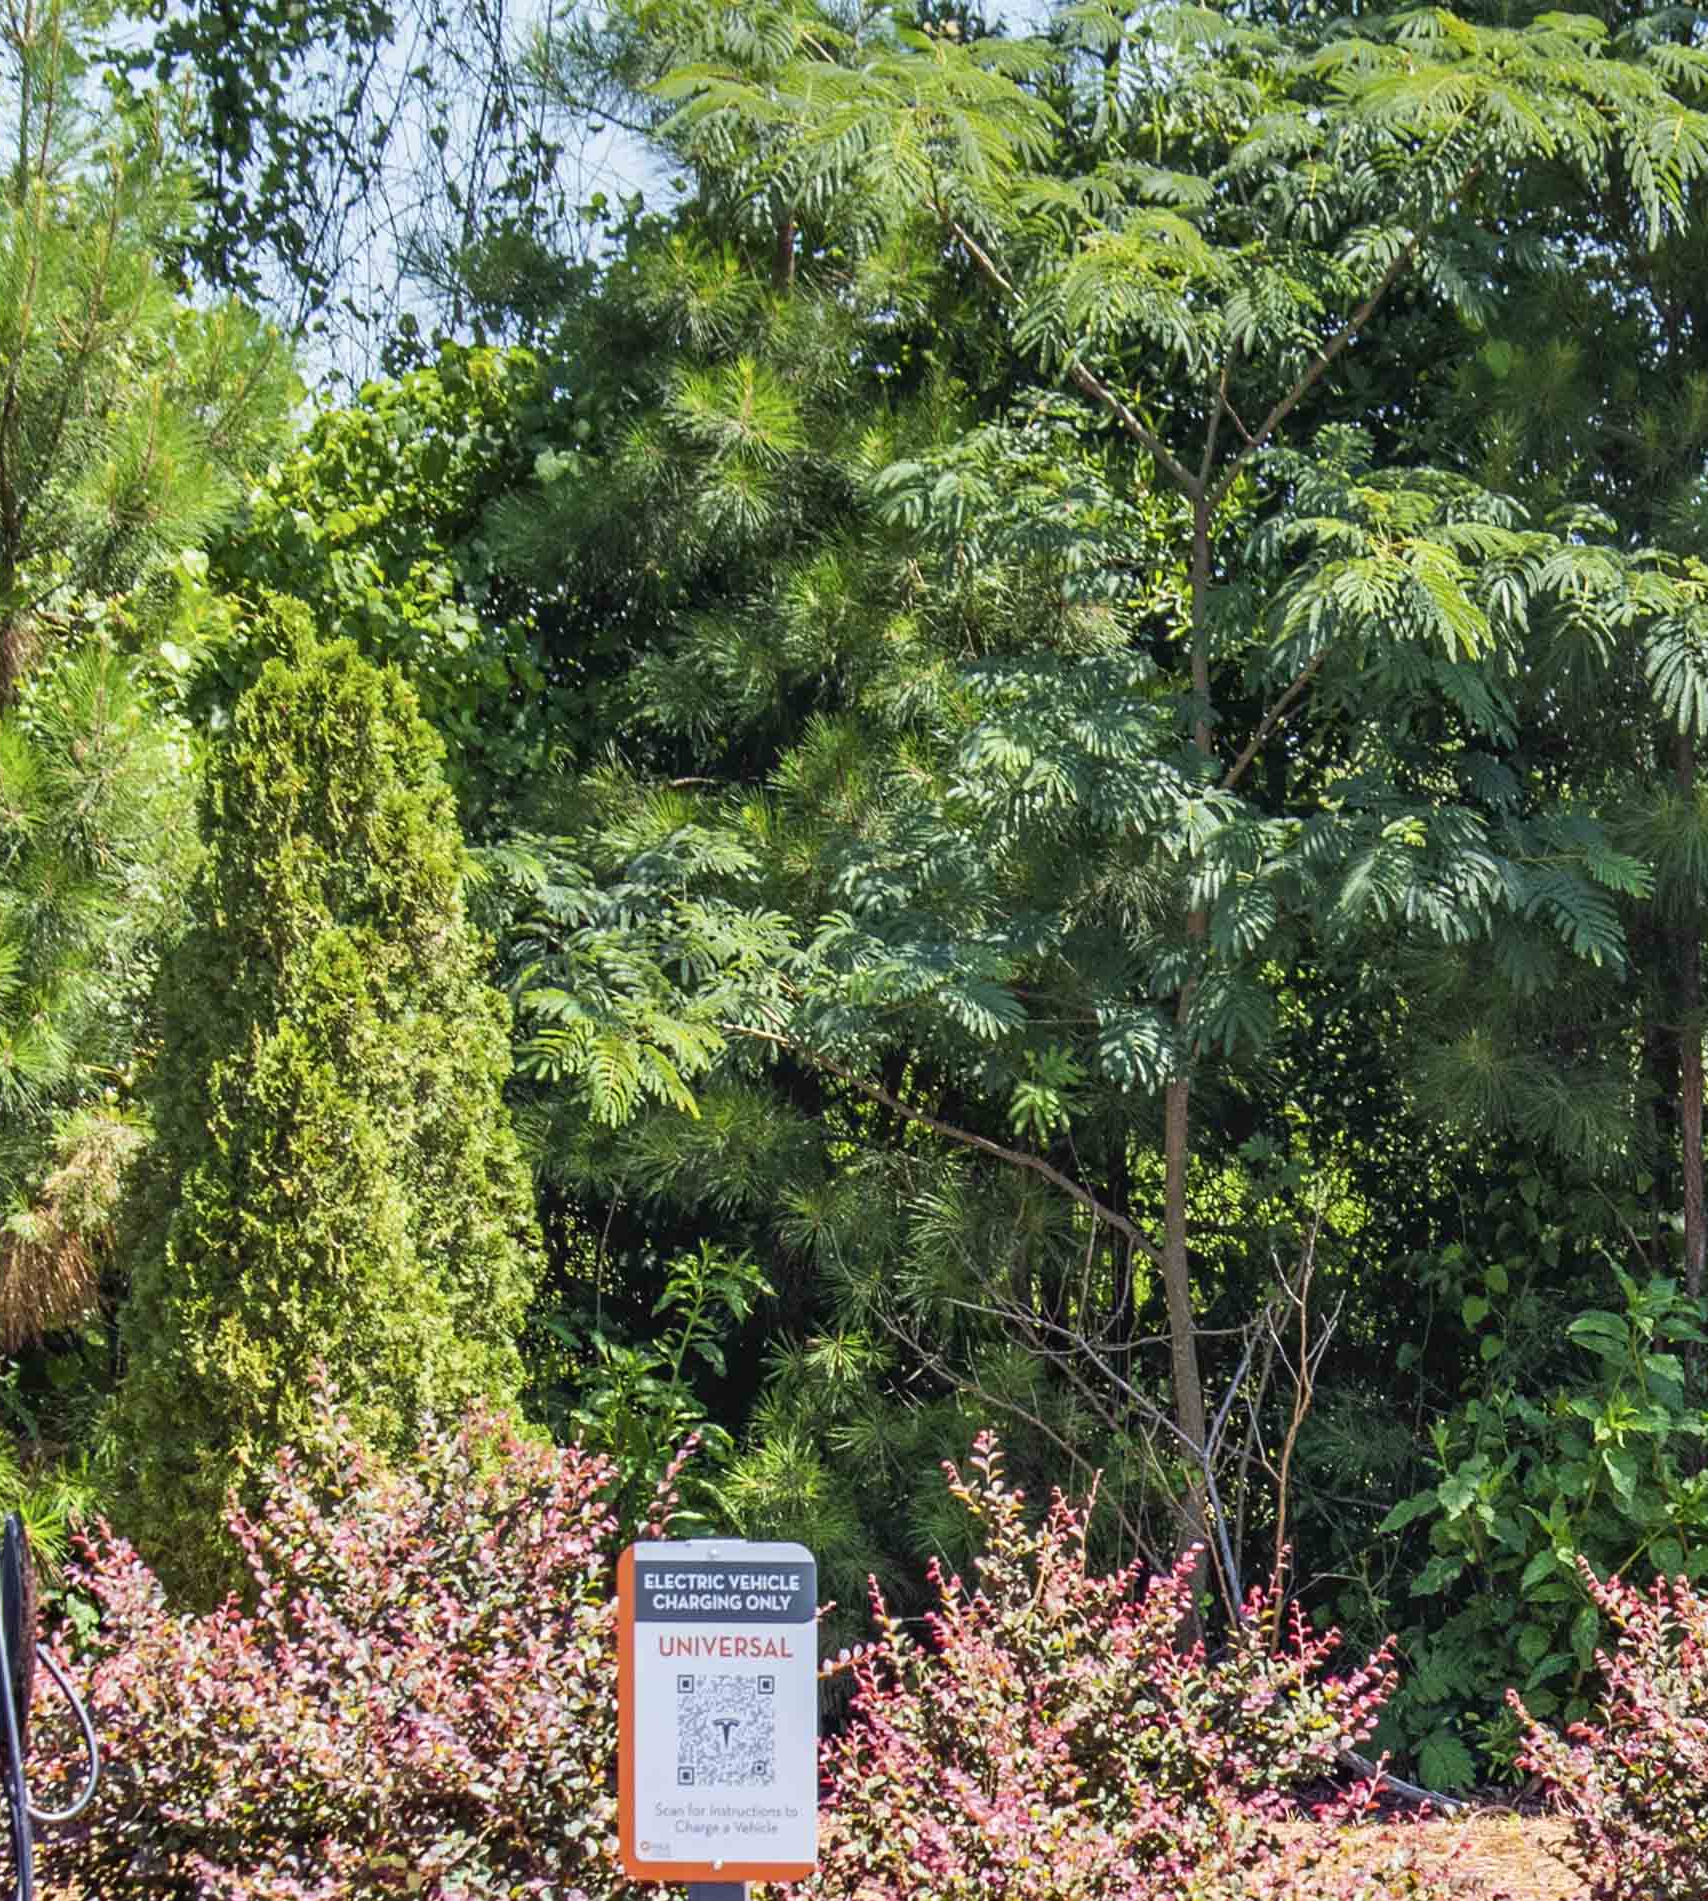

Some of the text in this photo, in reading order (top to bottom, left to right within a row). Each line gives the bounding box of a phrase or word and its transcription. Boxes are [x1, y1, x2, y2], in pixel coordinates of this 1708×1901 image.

[643, 1574, 800, 1591] ELECTRIC VEHICLE
[653, 1594, 791, 1611] CHARGING ONLY
[659, 1636, 793, 1658] UNIVERSAL
[655, 1802, 798, 1817] Scan for Instructions to
[675, 1819, 779, 1837] Charge a Vehicle
